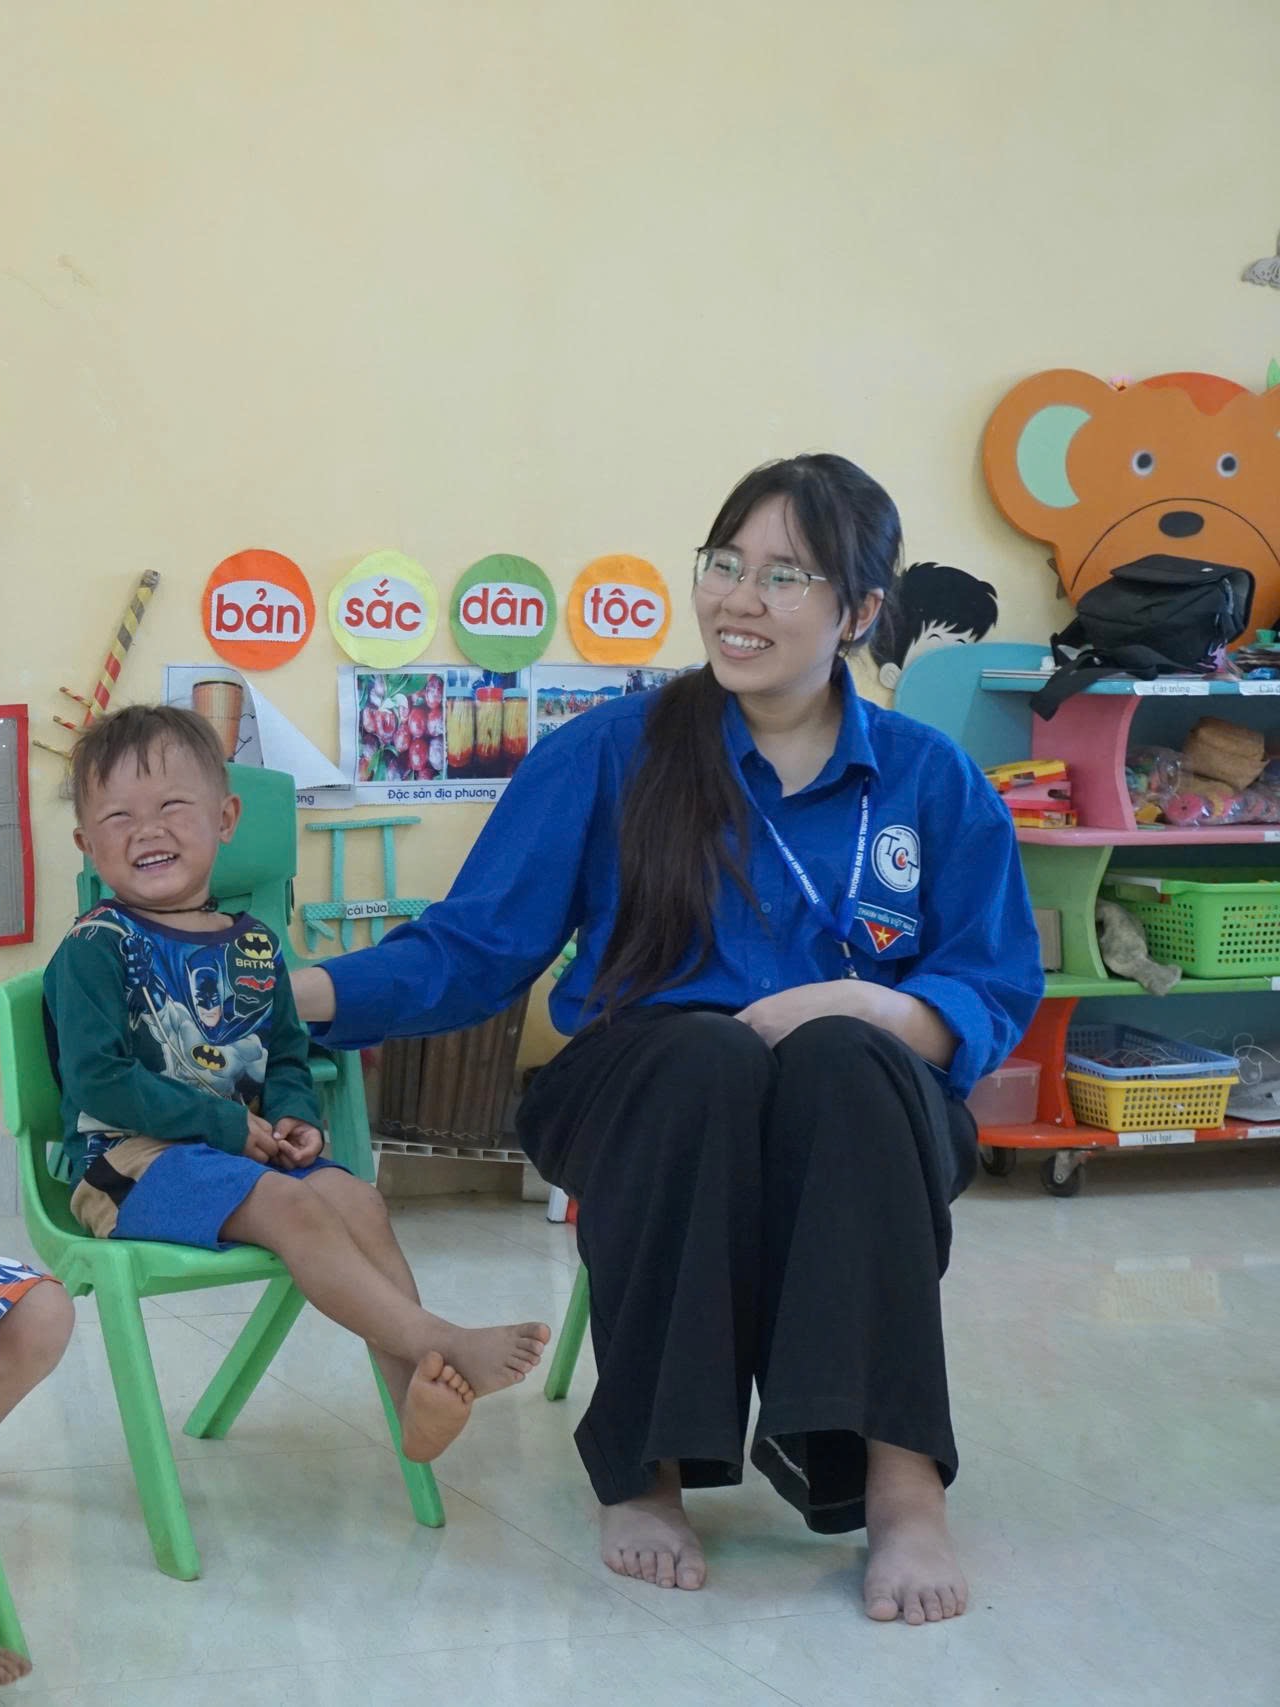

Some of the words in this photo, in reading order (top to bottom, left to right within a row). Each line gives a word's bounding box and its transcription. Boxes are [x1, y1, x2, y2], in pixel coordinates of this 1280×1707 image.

[215, 588, 301, 634] bản
[345, 578, 422, 632] sắc
[462, 587, 544, 627] dân
[590, 587, 656, 635] tộc
[387, 788, 410, 802] Đặc
[413, 787, 432, 799] sản
[435, 788, 452, 800] địa
[455, 788, 497, 800] phương
